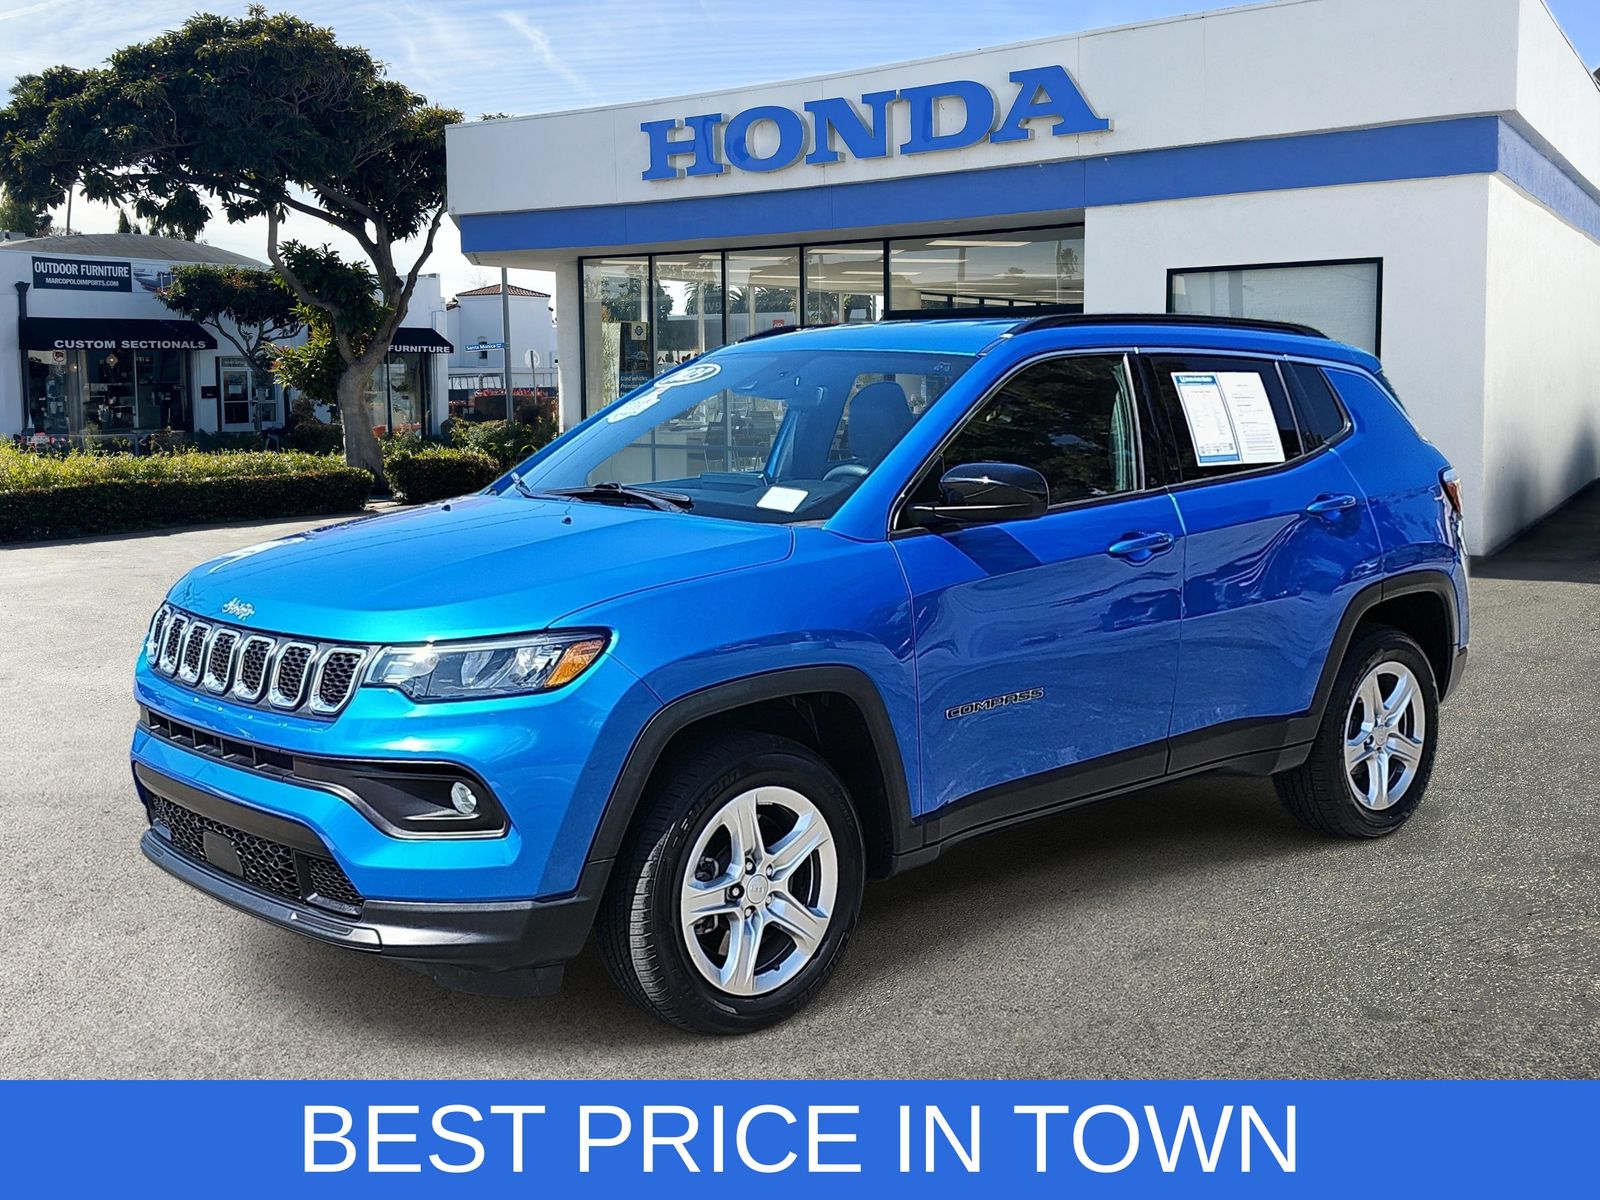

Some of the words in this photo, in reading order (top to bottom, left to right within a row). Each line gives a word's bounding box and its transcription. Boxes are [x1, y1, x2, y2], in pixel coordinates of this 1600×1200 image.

[640, 64, 1112, 182] HONDA
[34, 262, 79, 275] OUTDOOR
[80, 265, 129, 277] FURNITURE
[46, 278, 119, 287] MARCOPOLOIMPORTS.COM
[54, 339, 116, 349] CUSTOM
[121, 340, 206, 349] SECTIONALS
[388, 345, 450, 353] FURNITURE
[946, 687, 1045, 720] COMPASS
